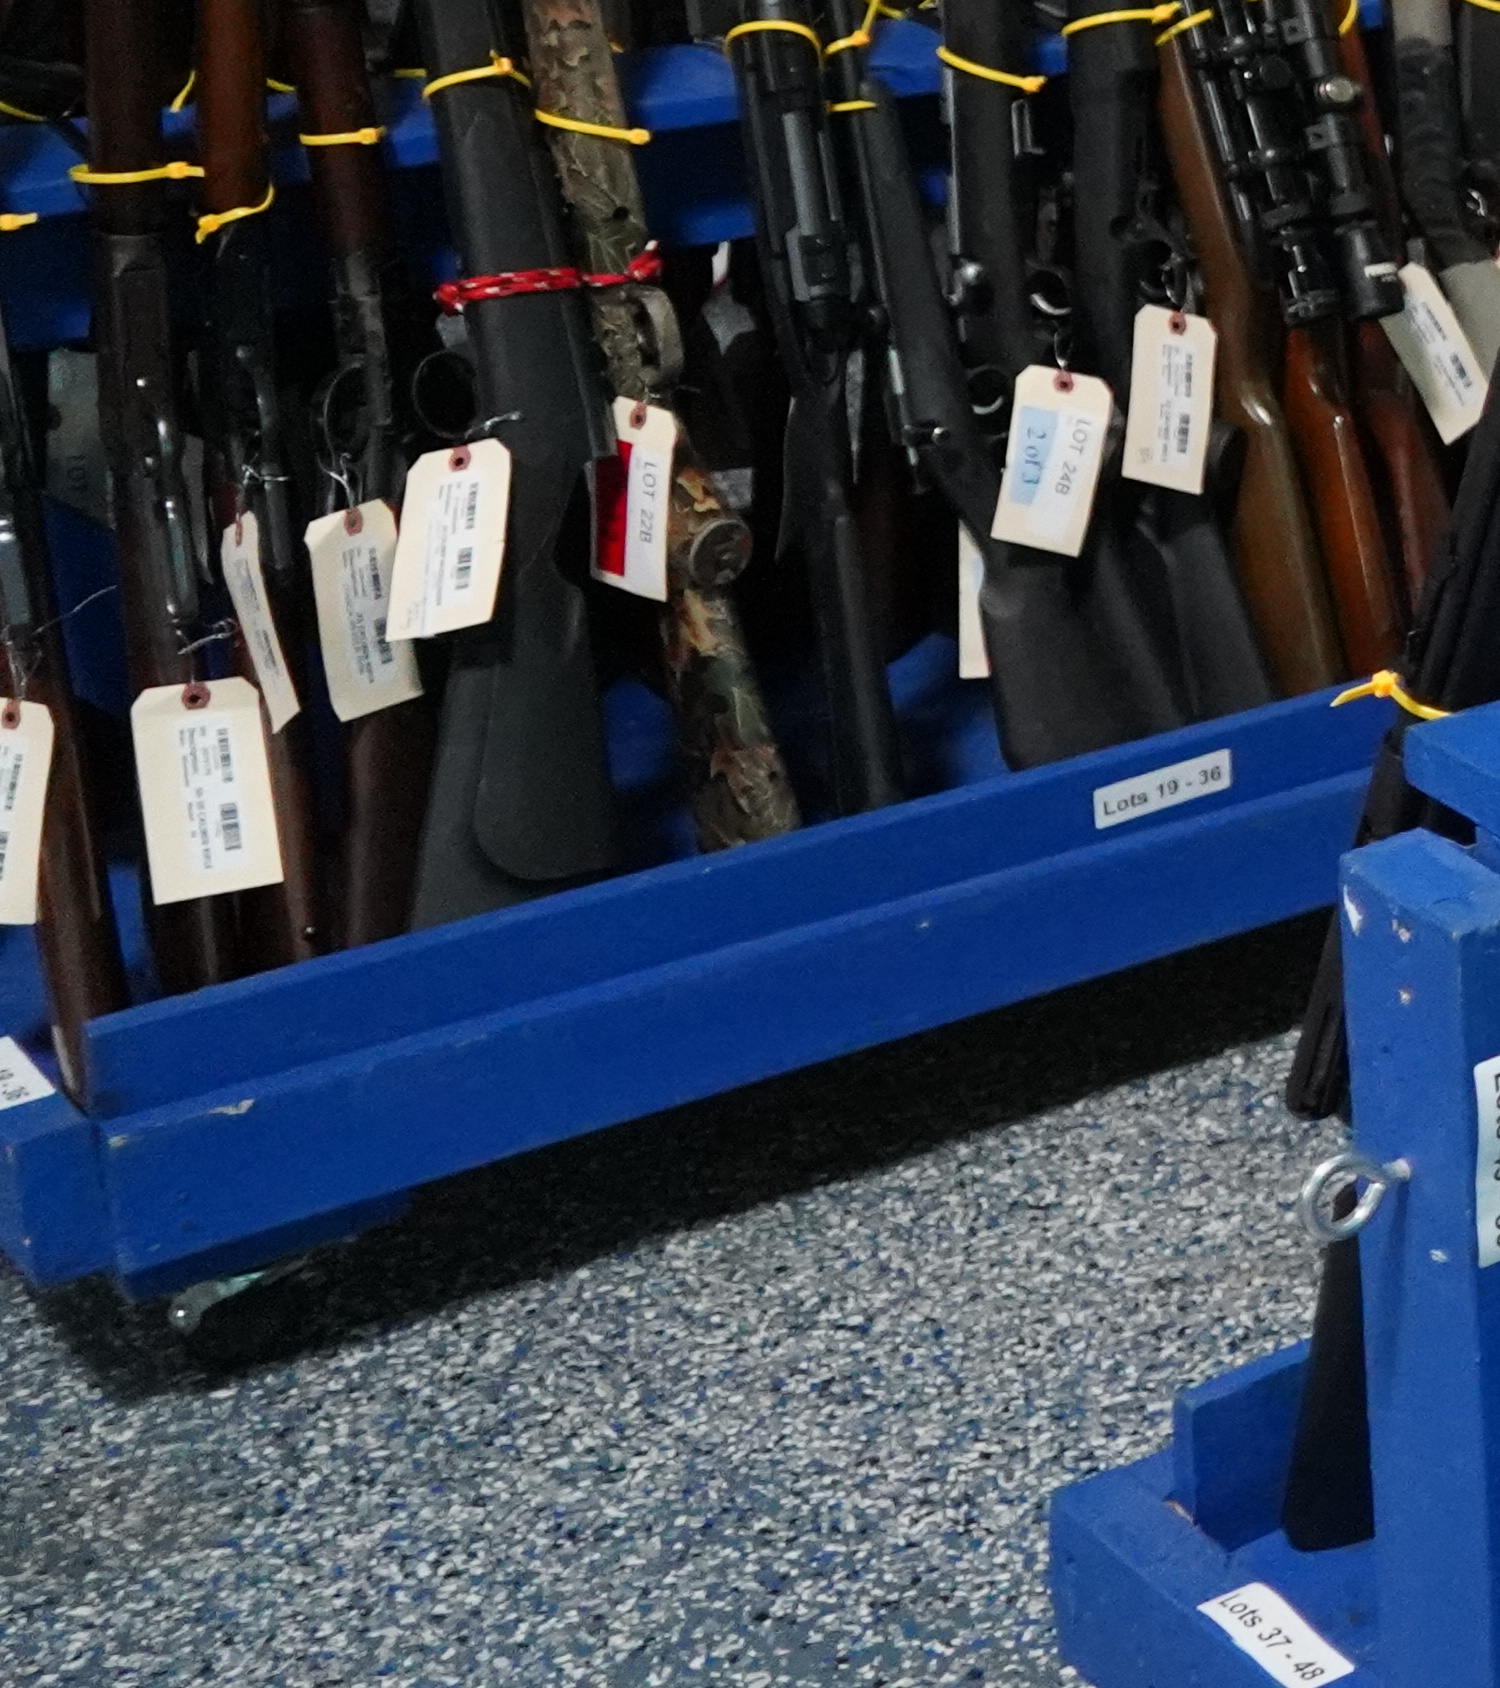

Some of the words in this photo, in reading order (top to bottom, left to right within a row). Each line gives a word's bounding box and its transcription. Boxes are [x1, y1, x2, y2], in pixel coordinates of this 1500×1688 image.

[1027, 427, 1047, 439] 2
[1069, 419, 1091, 455] LOT
[1025, 446, 1043, 469] of
[643, 461, 657, 500] LOT
[1022, 473, 1040, 485] 3
[1055, 462, 1077, 495] 24B
[640, 508, 654, 543] 22B
[1103, 793, 1148, 816] Lots
[1156, 779, 1178, 798] 19
[1199, 766, 1222, 785] 36
[1219, 1593, 1263, 1628] Lots
[1257, 1627, 1292, 1648] 37
[1293, 1662, 1325, 1681] 48
